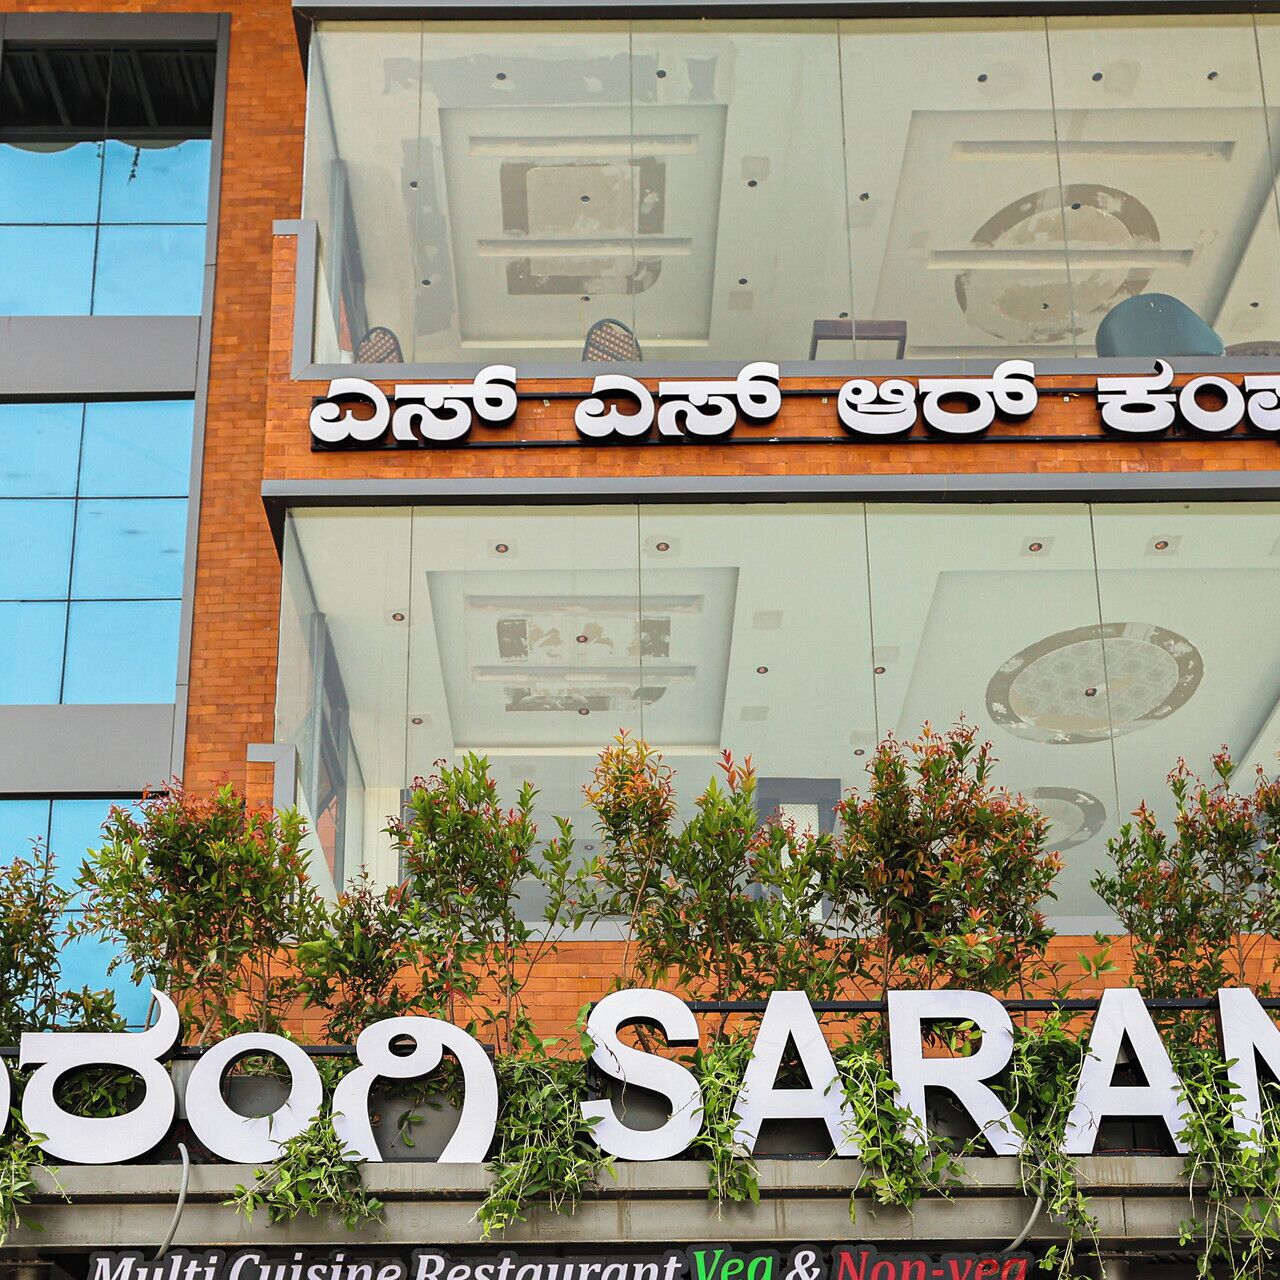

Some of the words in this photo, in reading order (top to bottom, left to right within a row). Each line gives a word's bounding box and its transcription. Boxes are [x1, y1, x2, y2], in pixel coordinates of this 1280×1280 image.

[308, 364, 518, 442] ಎಸ್
[573, 361, 782, 439] ಎಸ್
[837, 359, 1040, 436] ಆರ್
